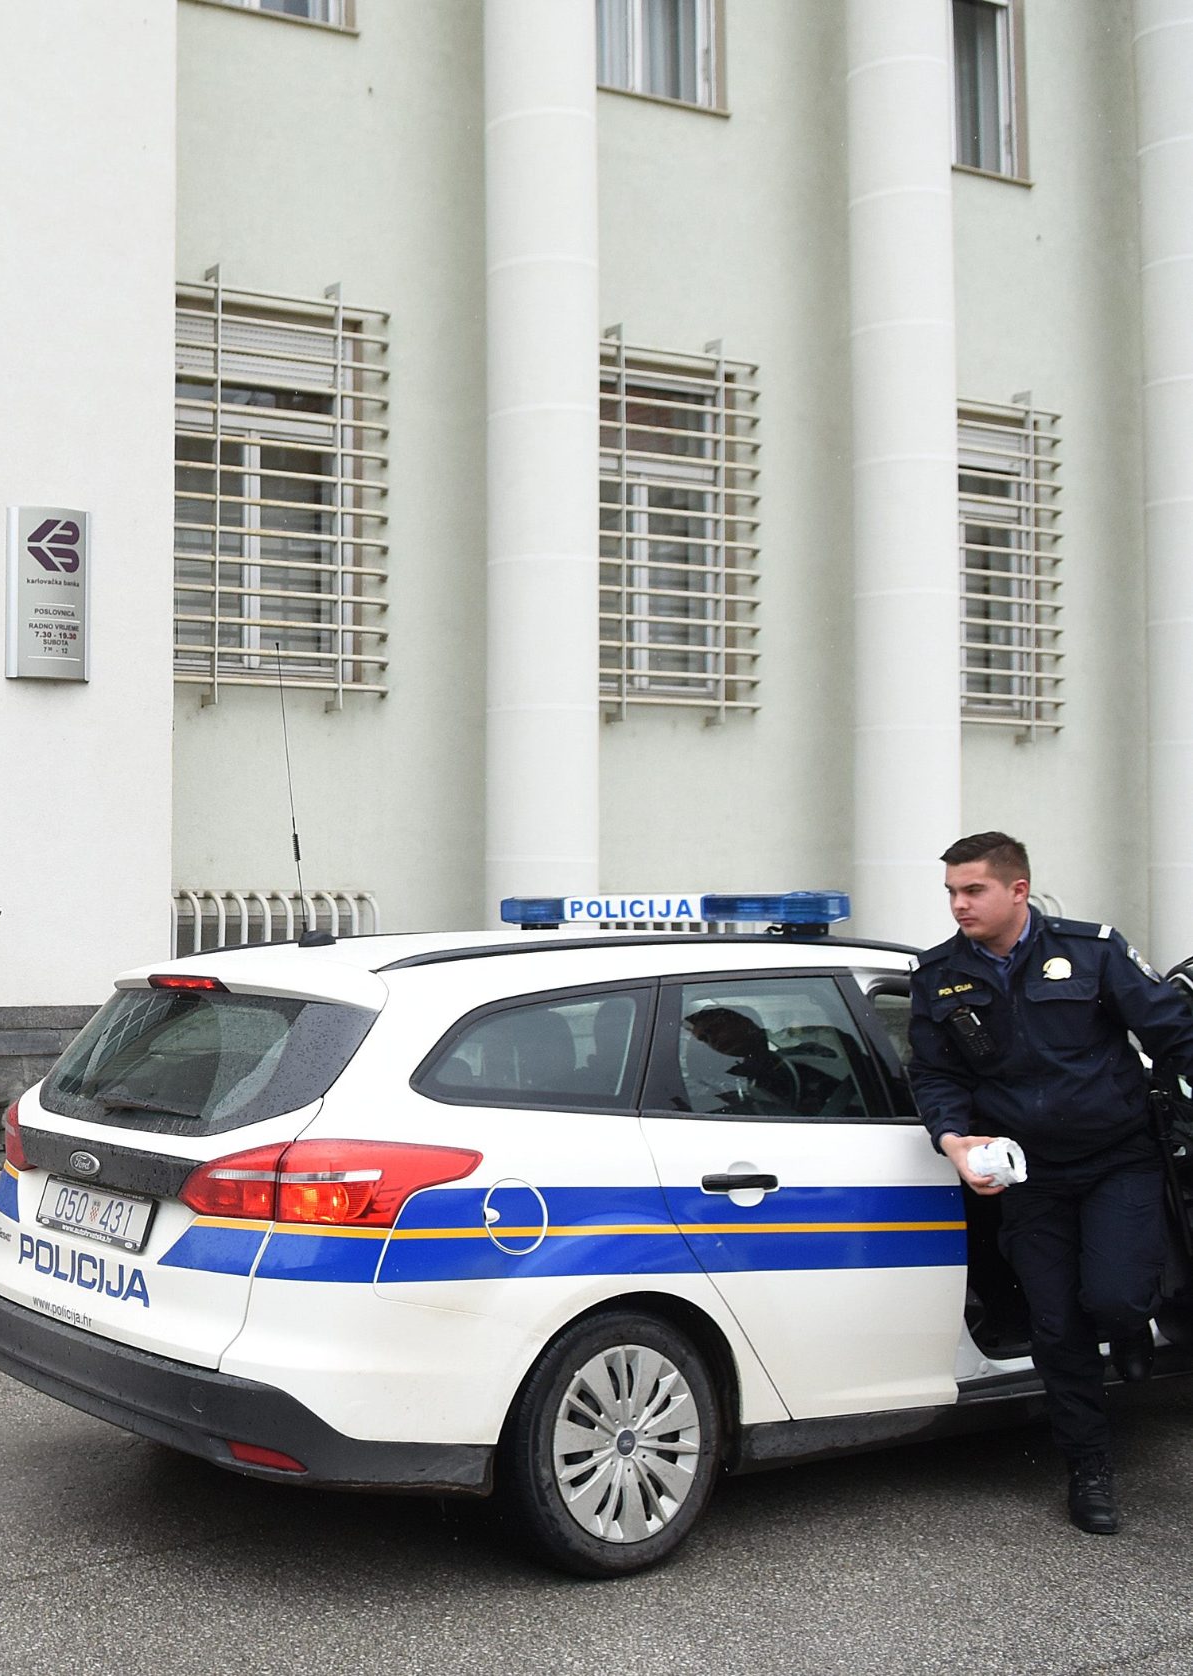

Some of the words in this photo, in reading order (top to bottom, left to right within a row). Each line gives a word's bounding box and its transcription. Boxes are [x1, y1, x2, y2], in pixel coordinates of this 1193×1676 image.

[26, 577, 62, 586] karlovačka
[63, 580, 80, 588] banka
[34, 608, 75, 617] POSLOVNICA
[28, 622, 54, 630] RADNO
[55, 624, 80, 632] VRIJEME
[34, 631, 52, 639] 7.30
[42, 639, 69, 647] SUBOTA
[570, 898, 693, 918] POLICIJA
[73, 1155, 91, 1170] Ford
[55, 1187, 89, 1224] 050
[99, 1200, 134, 1237] 431
[18, 1233, 150, 1308] POLICIJA
[32, 1296, 93, 1327] www.policija.hr
